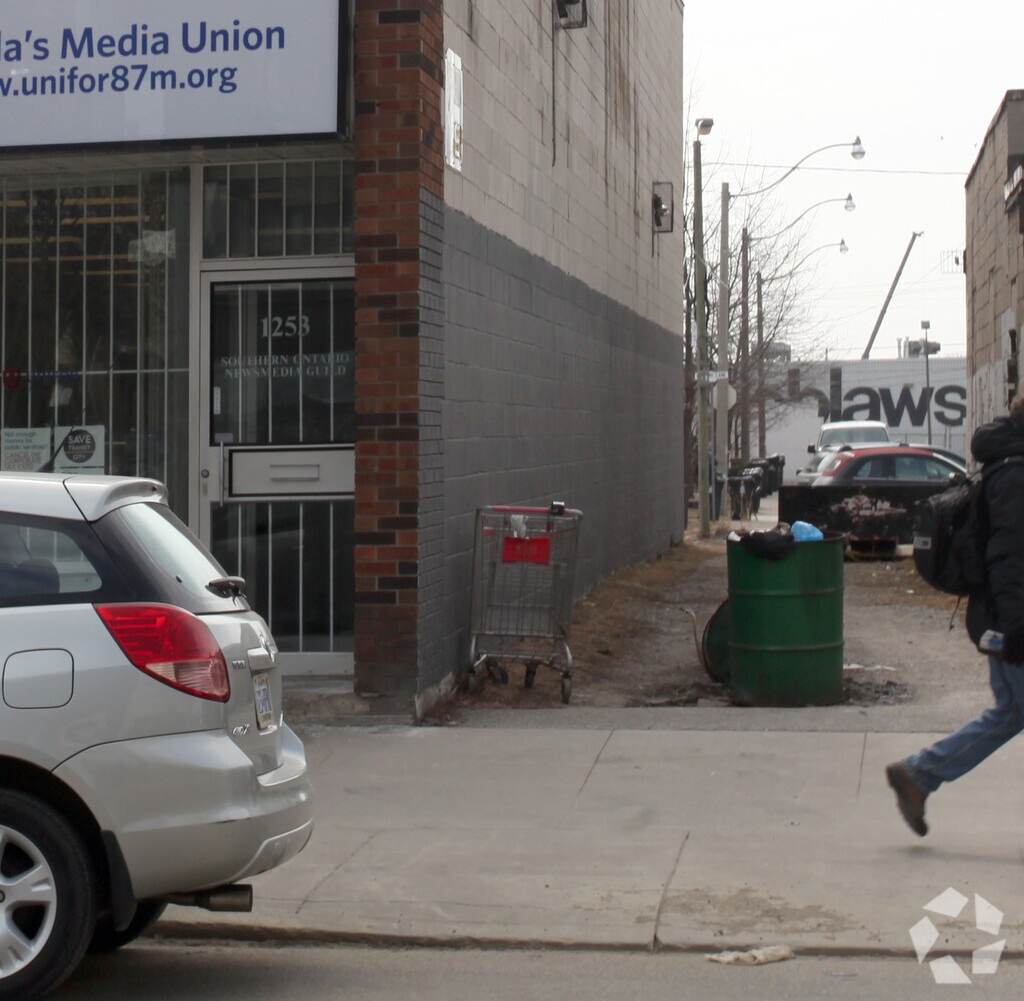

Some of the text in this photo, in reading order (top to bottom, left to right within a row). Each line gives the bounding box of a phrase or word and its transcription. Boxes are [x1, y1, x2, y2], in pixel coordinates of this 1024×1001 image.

[61, 24, 169, 59] Media
[181, 19, 285, 54] Union
[261, 315, 310, 337] 1253
[68, 435, 91, 444] SAVE
